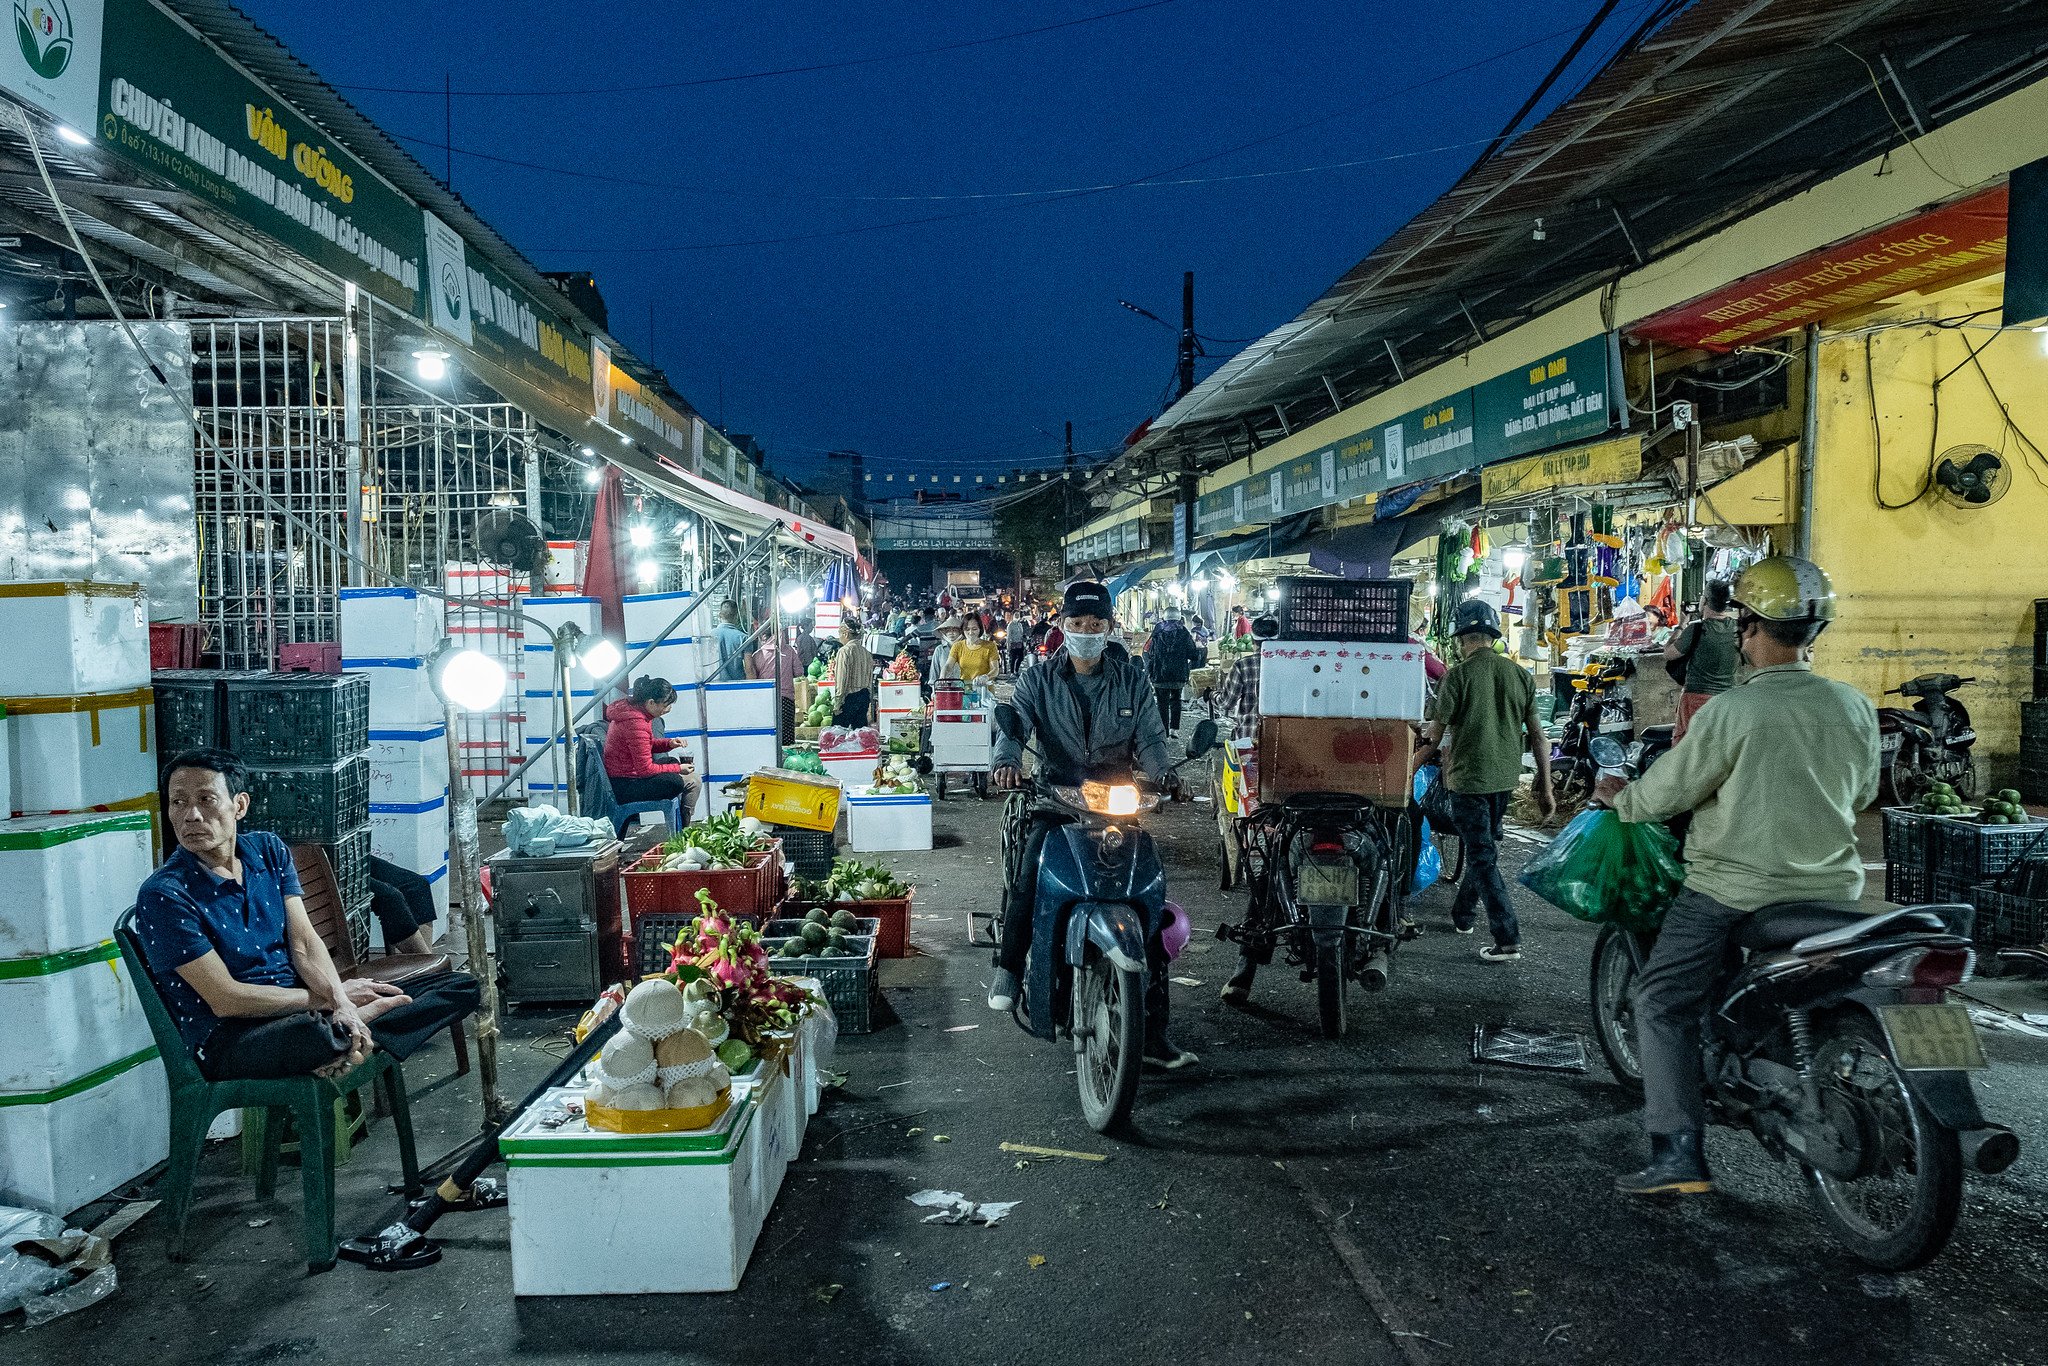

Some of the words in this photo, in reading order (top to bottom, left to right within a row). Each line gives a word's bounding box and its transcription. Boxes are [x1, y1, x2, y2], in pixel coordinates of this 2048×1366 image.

[111, 77, 186, 152] CHUYÊN
[185, 122, 226, 176] KINH
[225, 148, 275, 206] DOANH
[274, 178, 311, 226] BUÔN
[310, 201, 336, 242] BÁN
[335, 216, 358, 254] CÁC
[357, 231, 382, 272] LOẠI
[128, 131, 139, 150] số
[171, 156, 183, 175] C2
[184, 164, 199, 186] Chợ
[202, 173, 219, 199] Long
[245, 103, 287, 160] VÂN
[293, 142, 353, 204] CƯỜNG
[1700, 297, 1768, 322] NHIỆT
[1756, 280, 1814, 302] LIỆT
[1802, 252, 1896, 286] HƯỞNG
[1880, 233, 1953, 257] ỨNG
[491, 284, 520, 339] TRÁI
[1547, 356, 1568, 379] ANH
[1522, 396, 1537, 411] ĐẠI
[1536, 388, 1546, 405] LÝ
[1545, 386, 1560, 404] TẠP
[1586, 391, 1604, 413] ĐÈN
[1542, 460, 1554, 480] ĐẠI
[1554, 455, 1563, 476] LÝ
[1564, 455, 1577, 474] TẠP
